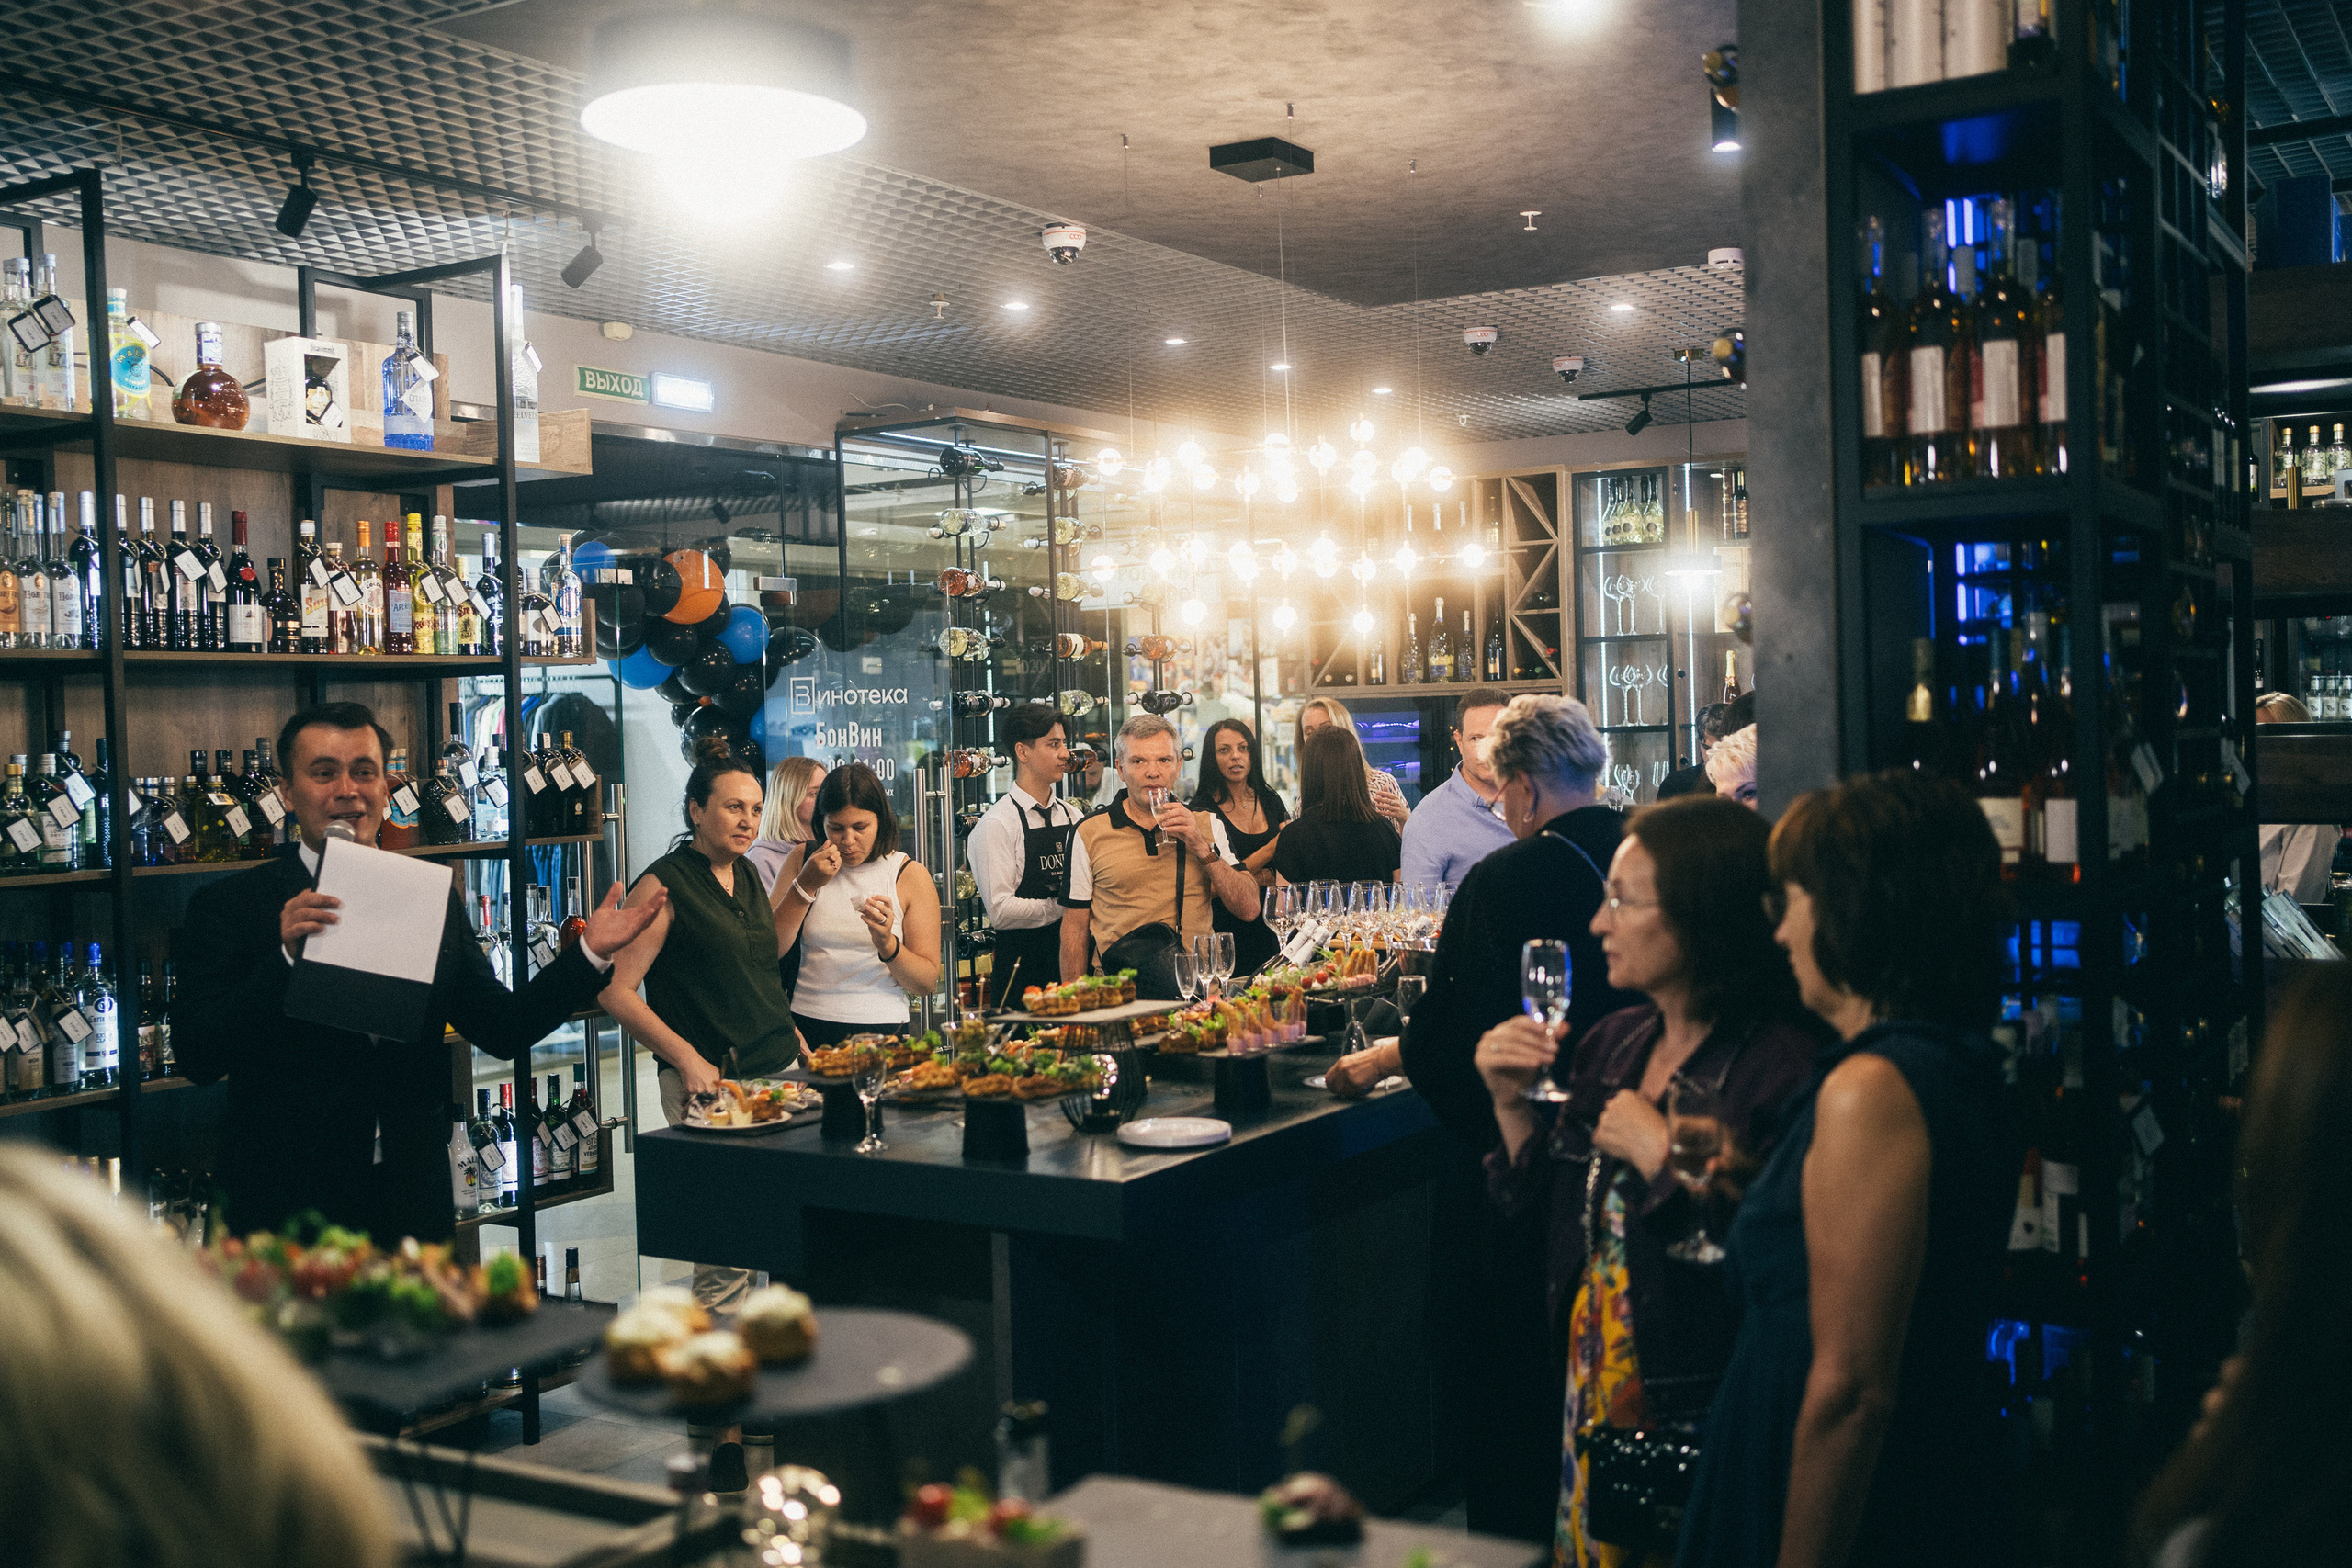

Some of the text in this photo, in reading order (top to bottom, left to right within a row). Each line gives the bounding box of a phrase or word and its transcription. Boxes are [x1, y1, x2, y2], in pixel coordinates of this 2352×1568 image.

[584, 370, 643, 398] ВЫХОД
[790, 677, 909, 714] Винотека
[816, 722, 882, 747] БонВин
